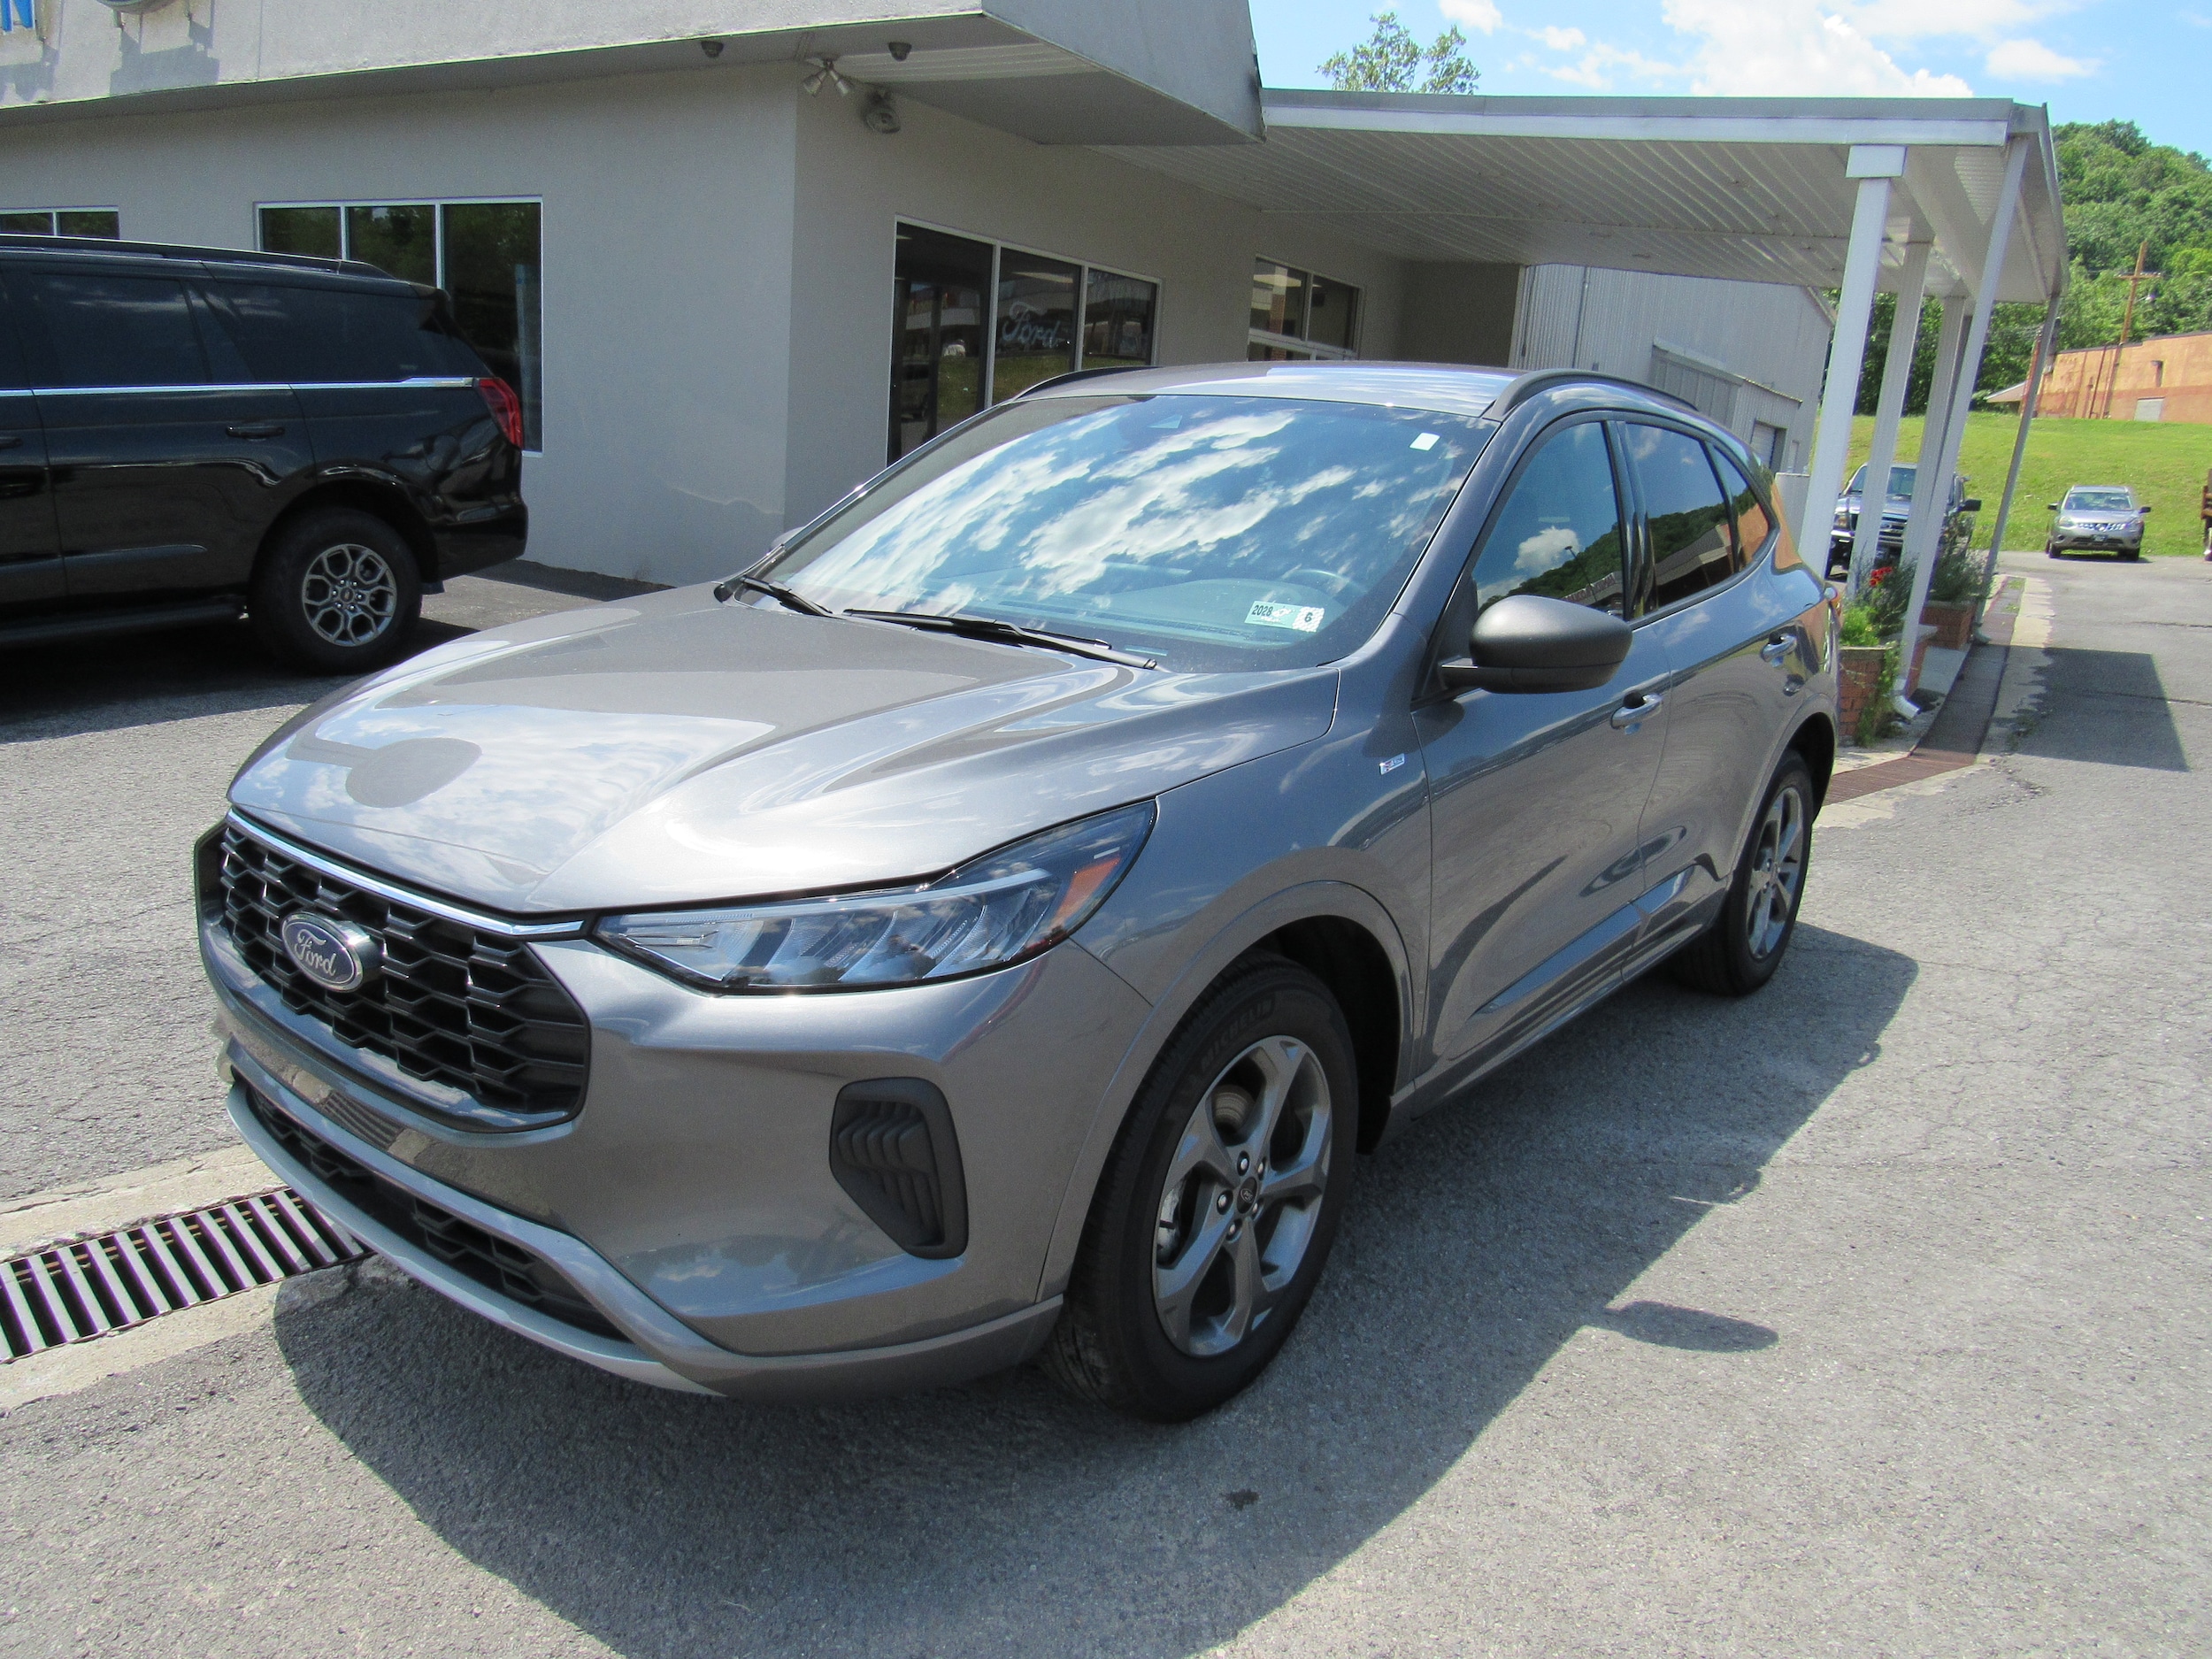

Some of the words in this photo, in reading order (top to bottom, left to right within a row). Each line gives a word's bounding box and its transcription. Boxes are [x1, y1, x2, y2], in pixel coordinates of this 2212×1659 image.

[1002, 301, 1063, 349] Ford
[1251, 604, 1274, 617] 2028
[1304, 611, 1314, 623] 6
[294, 929, 337, 977] Ford
